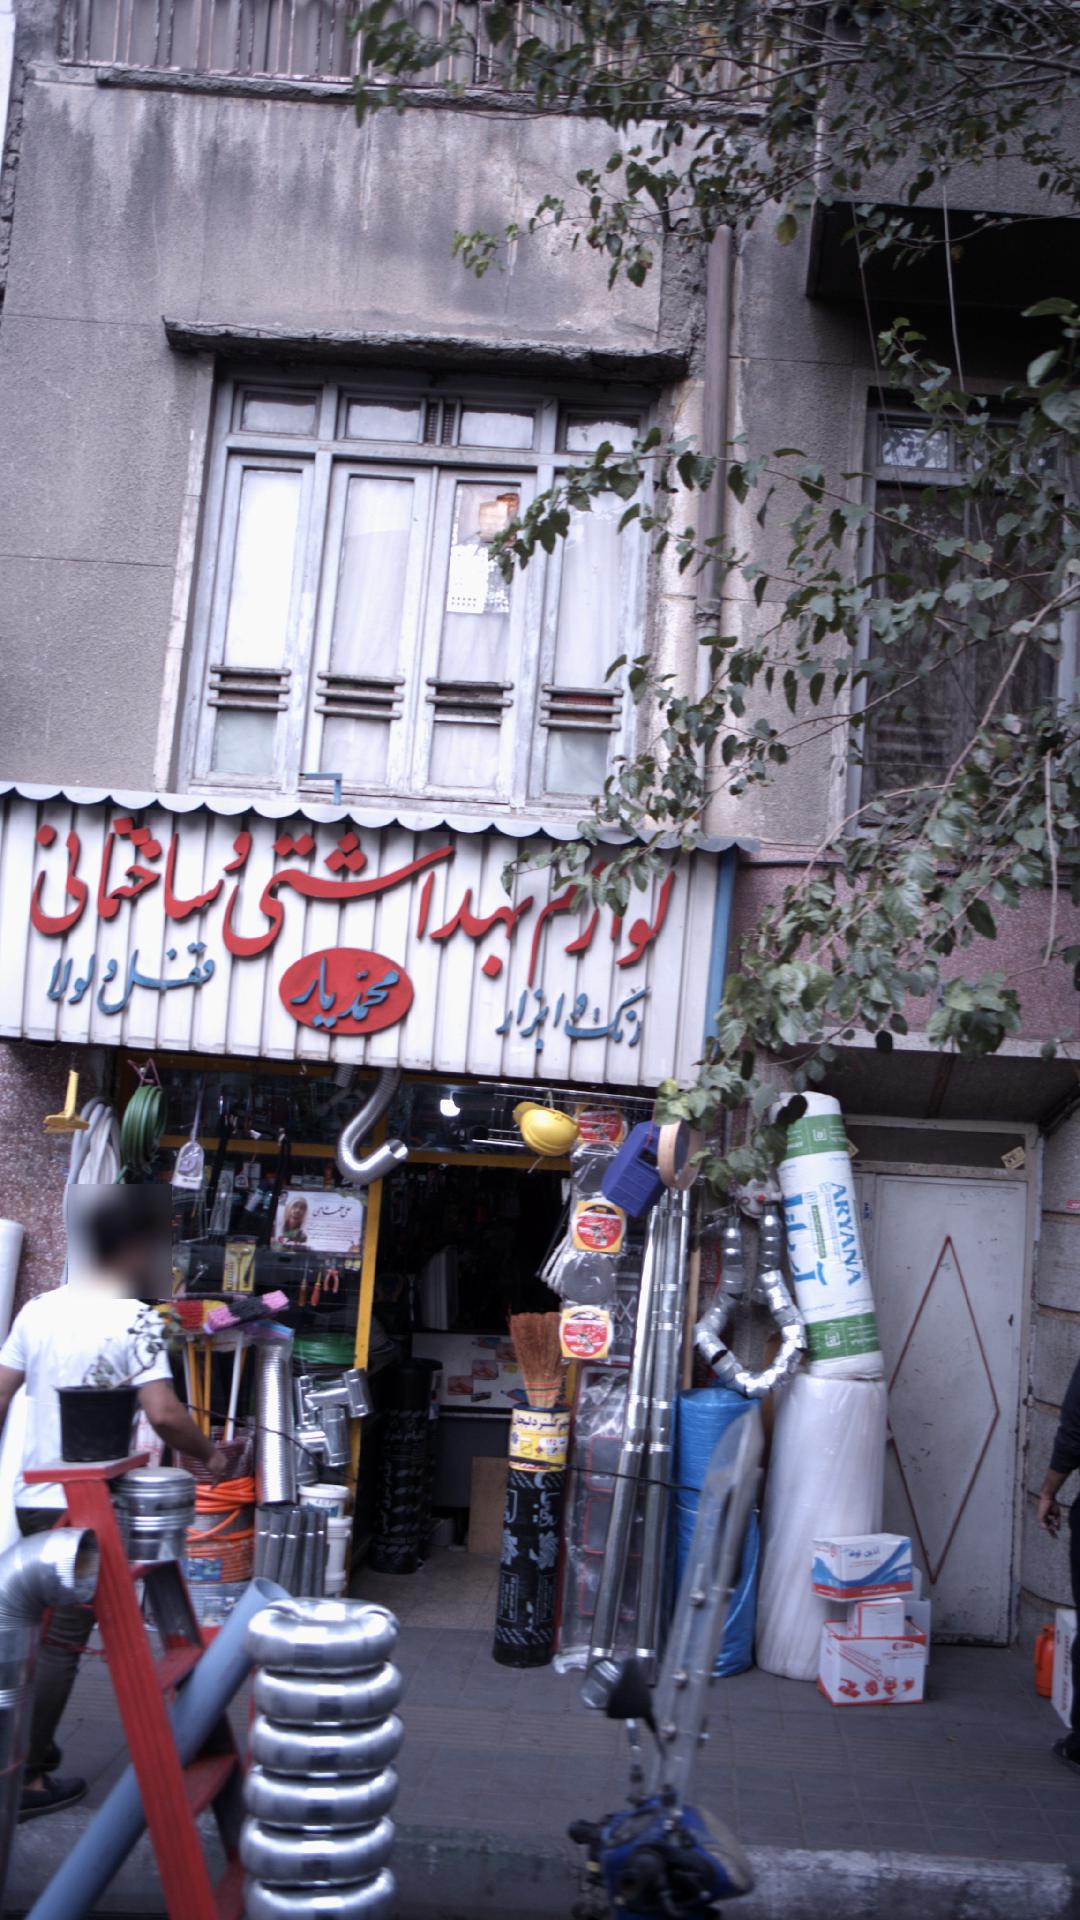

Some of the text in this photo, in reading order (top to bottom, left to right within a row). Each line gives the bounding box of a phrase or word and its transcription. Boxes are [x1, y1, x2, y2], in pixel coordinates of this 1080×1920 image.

[31, 816, 225, 936] ساختمانی
[223, 831, 253, 872] و
[222, 832, 534, 977] بهداشتی
[47, 942, 215, 1016] قفل و لولا
[831, 1182, 862, 1286] ARYANA
